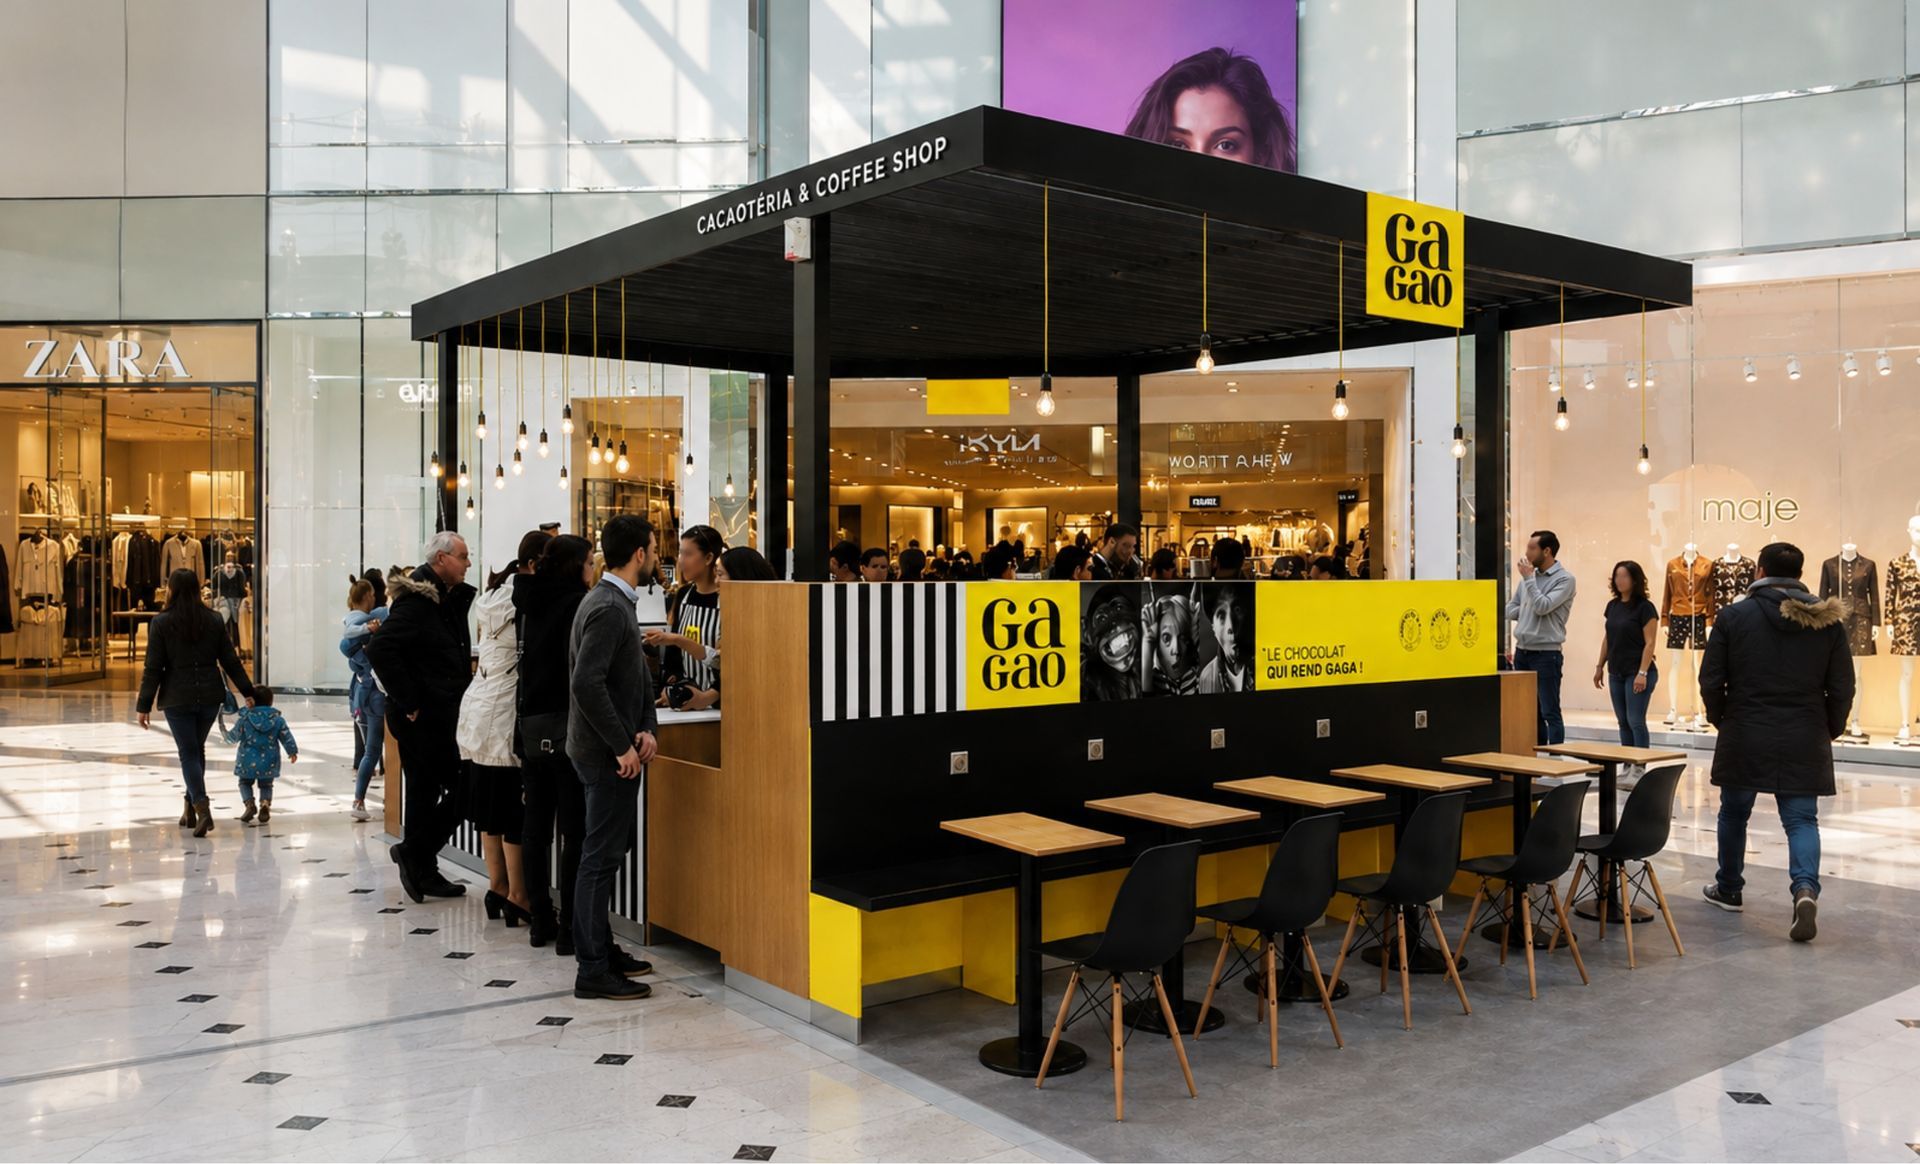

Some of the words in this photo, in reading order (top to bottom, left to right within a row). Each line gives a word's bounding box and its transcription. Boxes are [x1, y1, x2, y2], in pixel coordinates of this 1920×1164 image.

[697, 187, 793, 235] CACAOTÉRIA
[798, 182, 810, 203] &
[816, 156, 886, 197] COFFEE
[892, 136, 947, 173] SHOP
[1385, 213, 1452, 272] Ga
[23, 339, 193, 378] ZARA
[1703, 491, 1798, 527] maje
[982, 598, 1066, 651] Ga
[1267, 665, 1288, 679] QUI
[1291, 663, 1323, 678] REND
[1325, 661, 1357, 675] GAGA
[1284, 645, 1346, 661] CHOCOLAT
